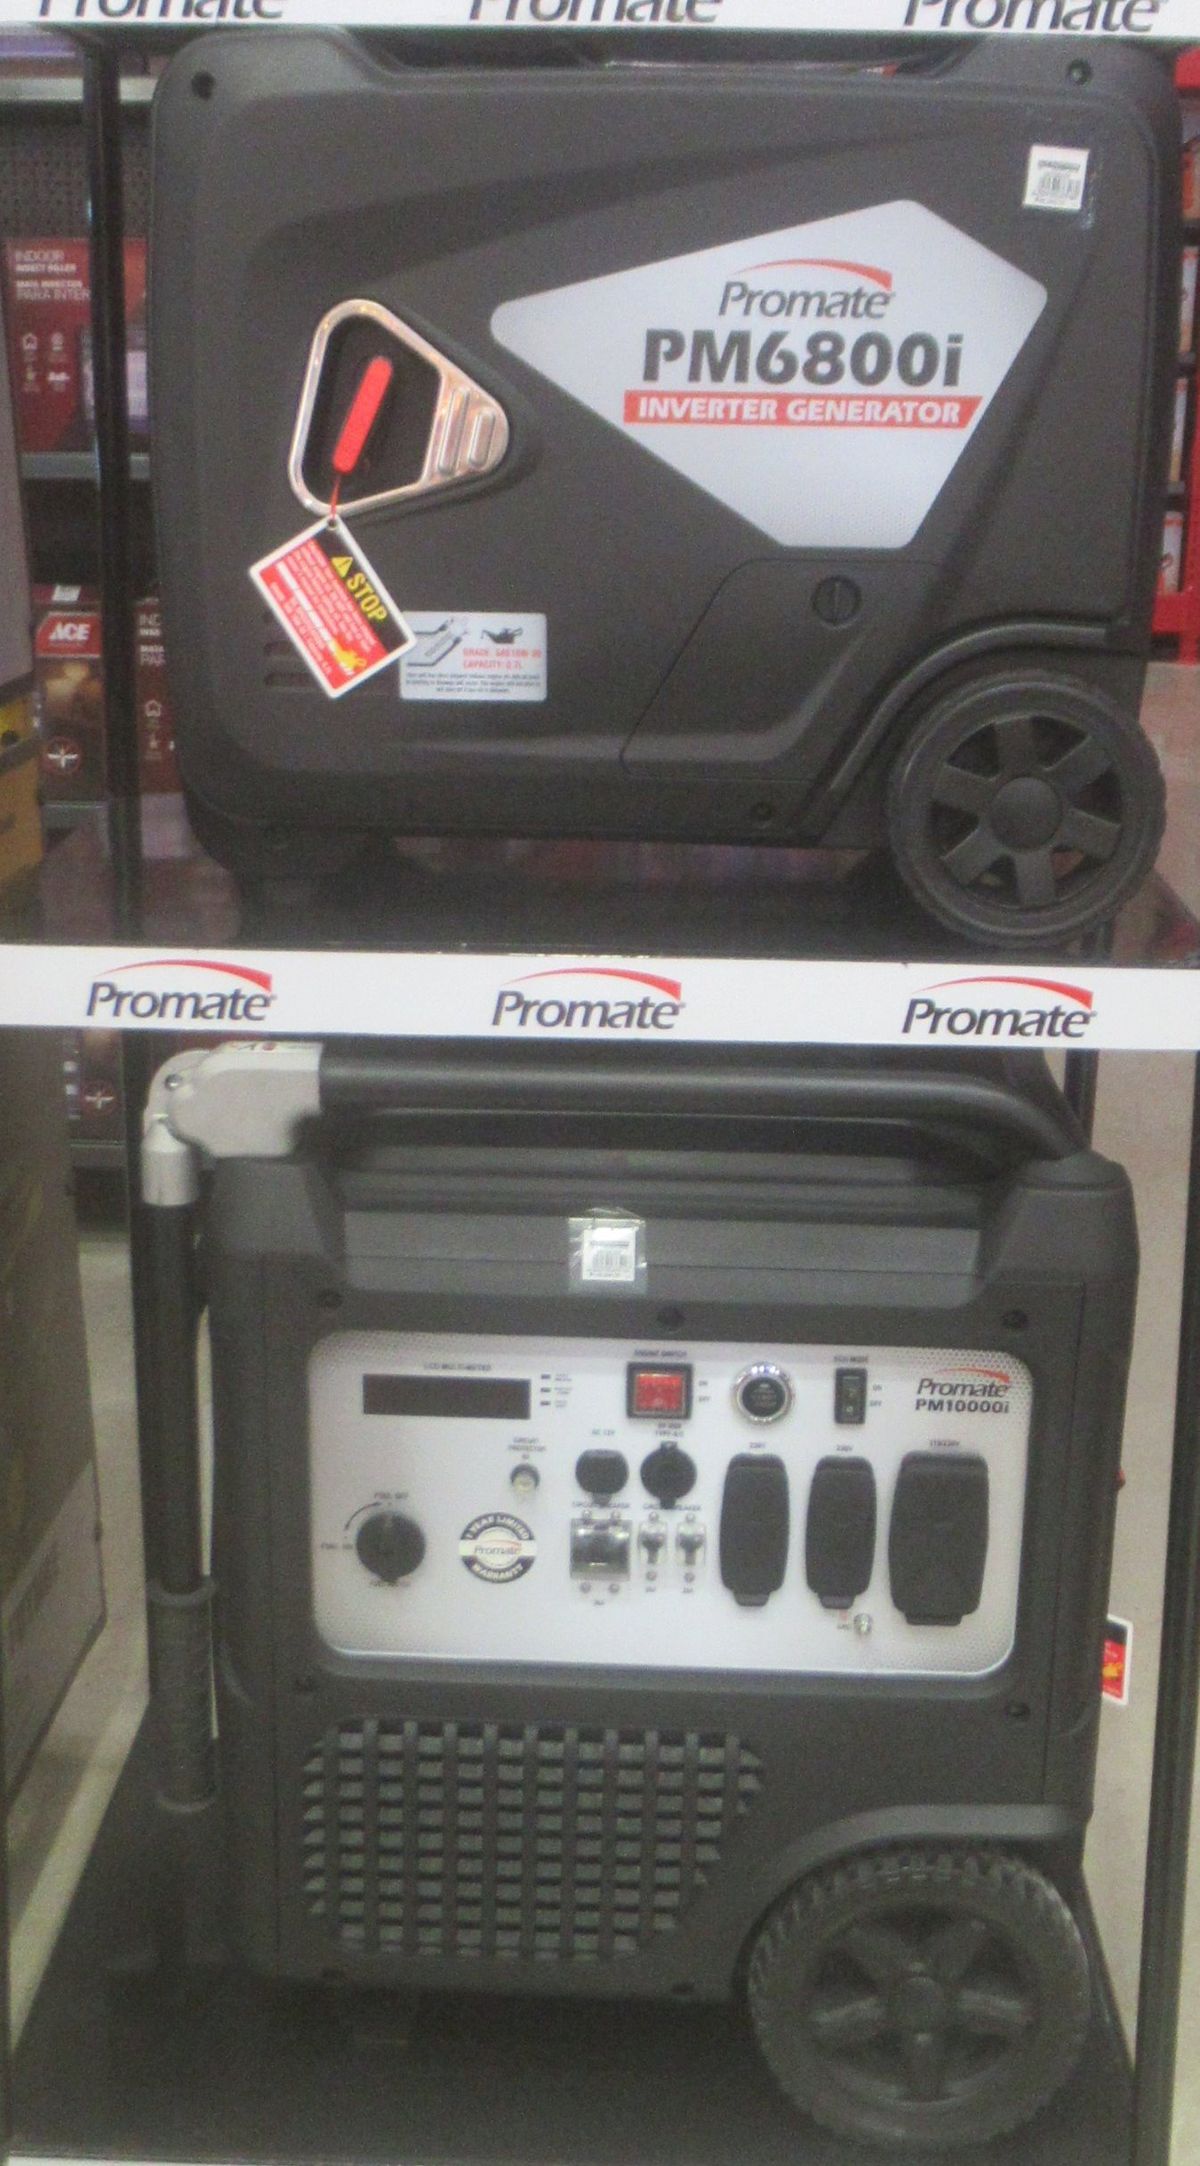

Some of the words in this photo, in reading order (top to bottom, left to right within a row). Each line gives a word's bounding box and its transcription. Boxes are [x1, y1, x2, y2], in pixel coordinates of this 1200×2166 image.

[718, 280, 895, 319] Promate
[643, 328, 963, 388] PM6800i
[638, 397, 777, 421] INVERTER
[786, 399, 961, 425] GENERATOR
[346, 572, 388, 621] STOP
[49, 623, 90, 641] ACE
[86, 981, 277, 1021] Promate
[491, 989, 686, 1030] Promate
[901, 998, 1096, 1038] Promate
[917, 1378, 1010, 1398] Promate
[915, 1398, 1010, 1414] PM10000i
[496, 1515, 530, 1540] LIMITED
[474, 1545, 521, 1556] Promate
[471, 1562, 524, 1580] WARRANTY
